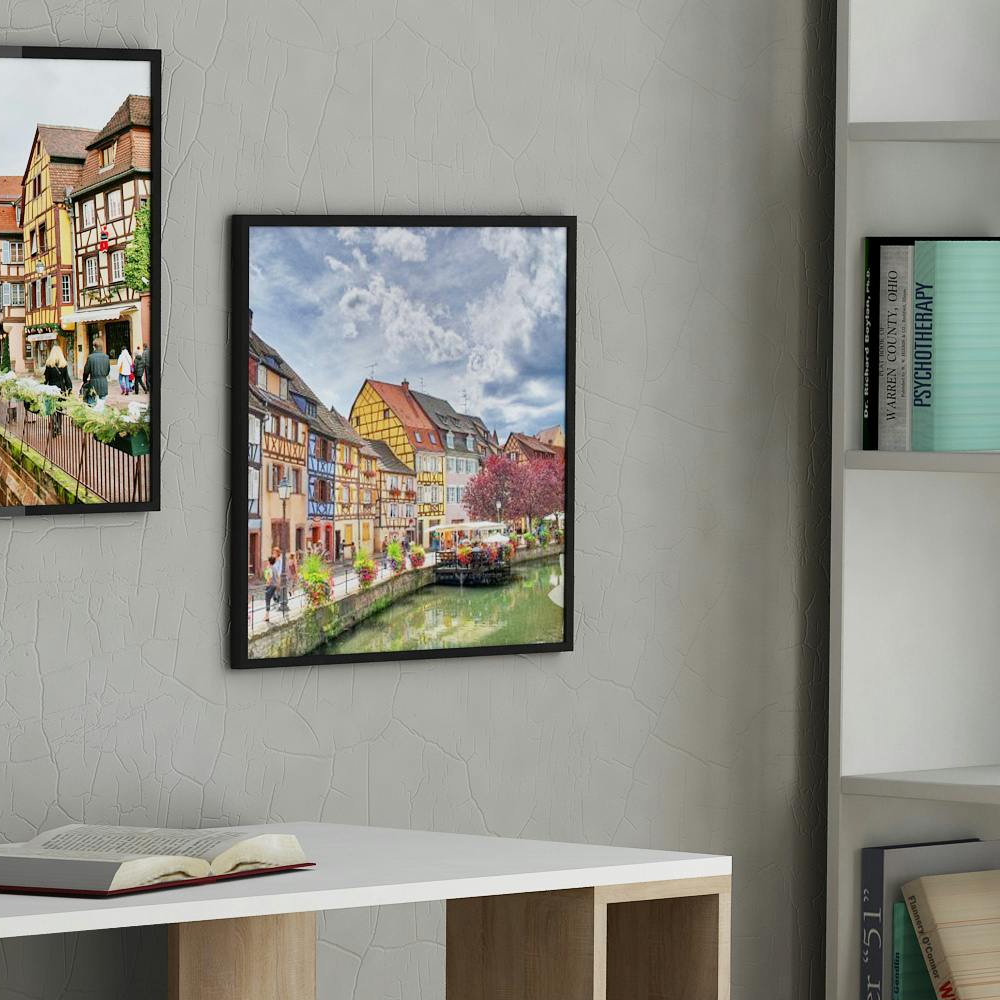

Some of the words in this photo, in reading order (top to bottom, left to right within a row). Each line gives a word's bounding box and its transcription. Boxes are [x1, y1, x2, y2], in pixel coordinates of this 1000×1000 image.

[888, 270, 898, 302] OHIO
[887, 308, 898, 362] COUNTY,
[914, 282, 933, 408] PSYCHOTHERAPY
[886, 368, 897, 420] WARREN
[908, 895, 924, 936] Flannery
[923, 936, 940, 979] O'Connor
